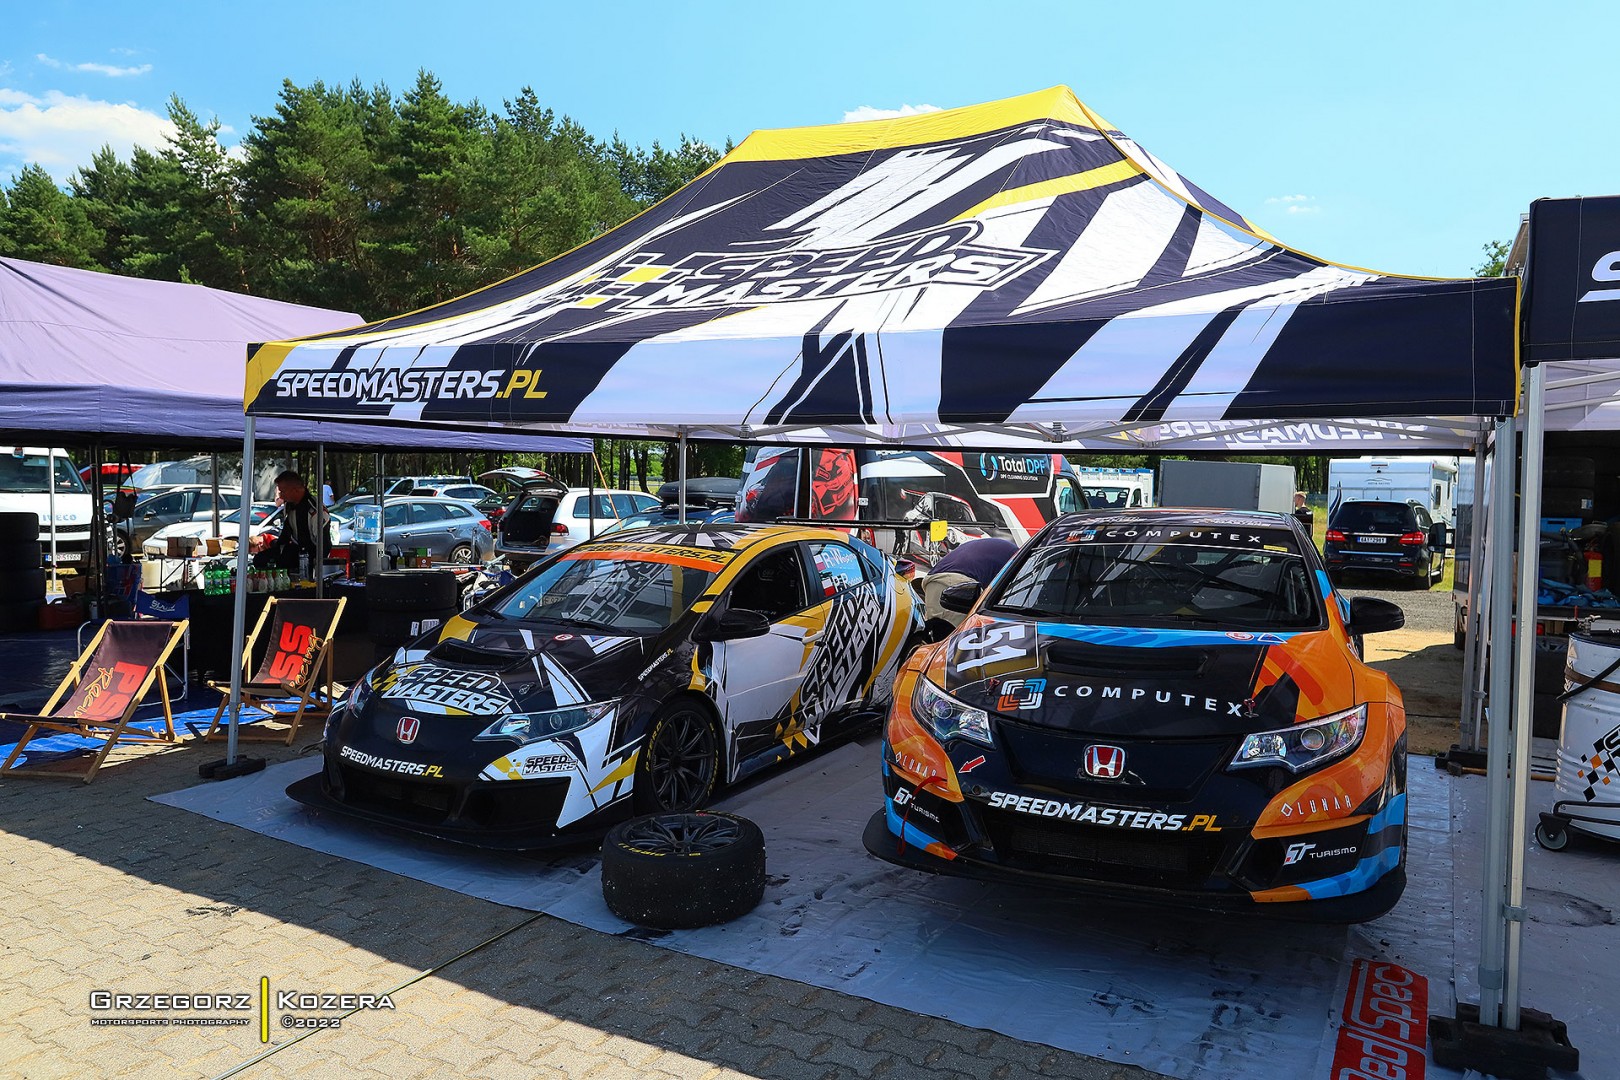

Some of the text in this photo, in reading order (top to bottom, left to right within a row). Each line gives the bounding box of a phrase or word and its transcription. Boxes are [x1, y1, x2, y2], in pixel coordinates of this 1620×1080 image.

[697, 222, 981, 281] SPEED
[645, 248, 1018, 308] MASTERS
[276, 369, 548, 399] SPEEDMASTERS.PL
[1106, 530, 1261, 543] COMPUTEX
[957, 625, 1026, 672] 51
[401, 667, 502, 694] SPEED
[382, 683, 507, 716] MASTERS
[1054, 685, 1242, 717] COMPUTEX
[340, 745, 443, 778] SPEEDMASTERS.PL
[523, 762, 577, 775] MASTERS
[526, 755, 568, 766] SPEED
[988, 791, 1222, 831] SPEEDMASTERS.PL
[1297, 794, 1352, 815] LUNAR
[1309, 846, 1357, 859] TURISMO
